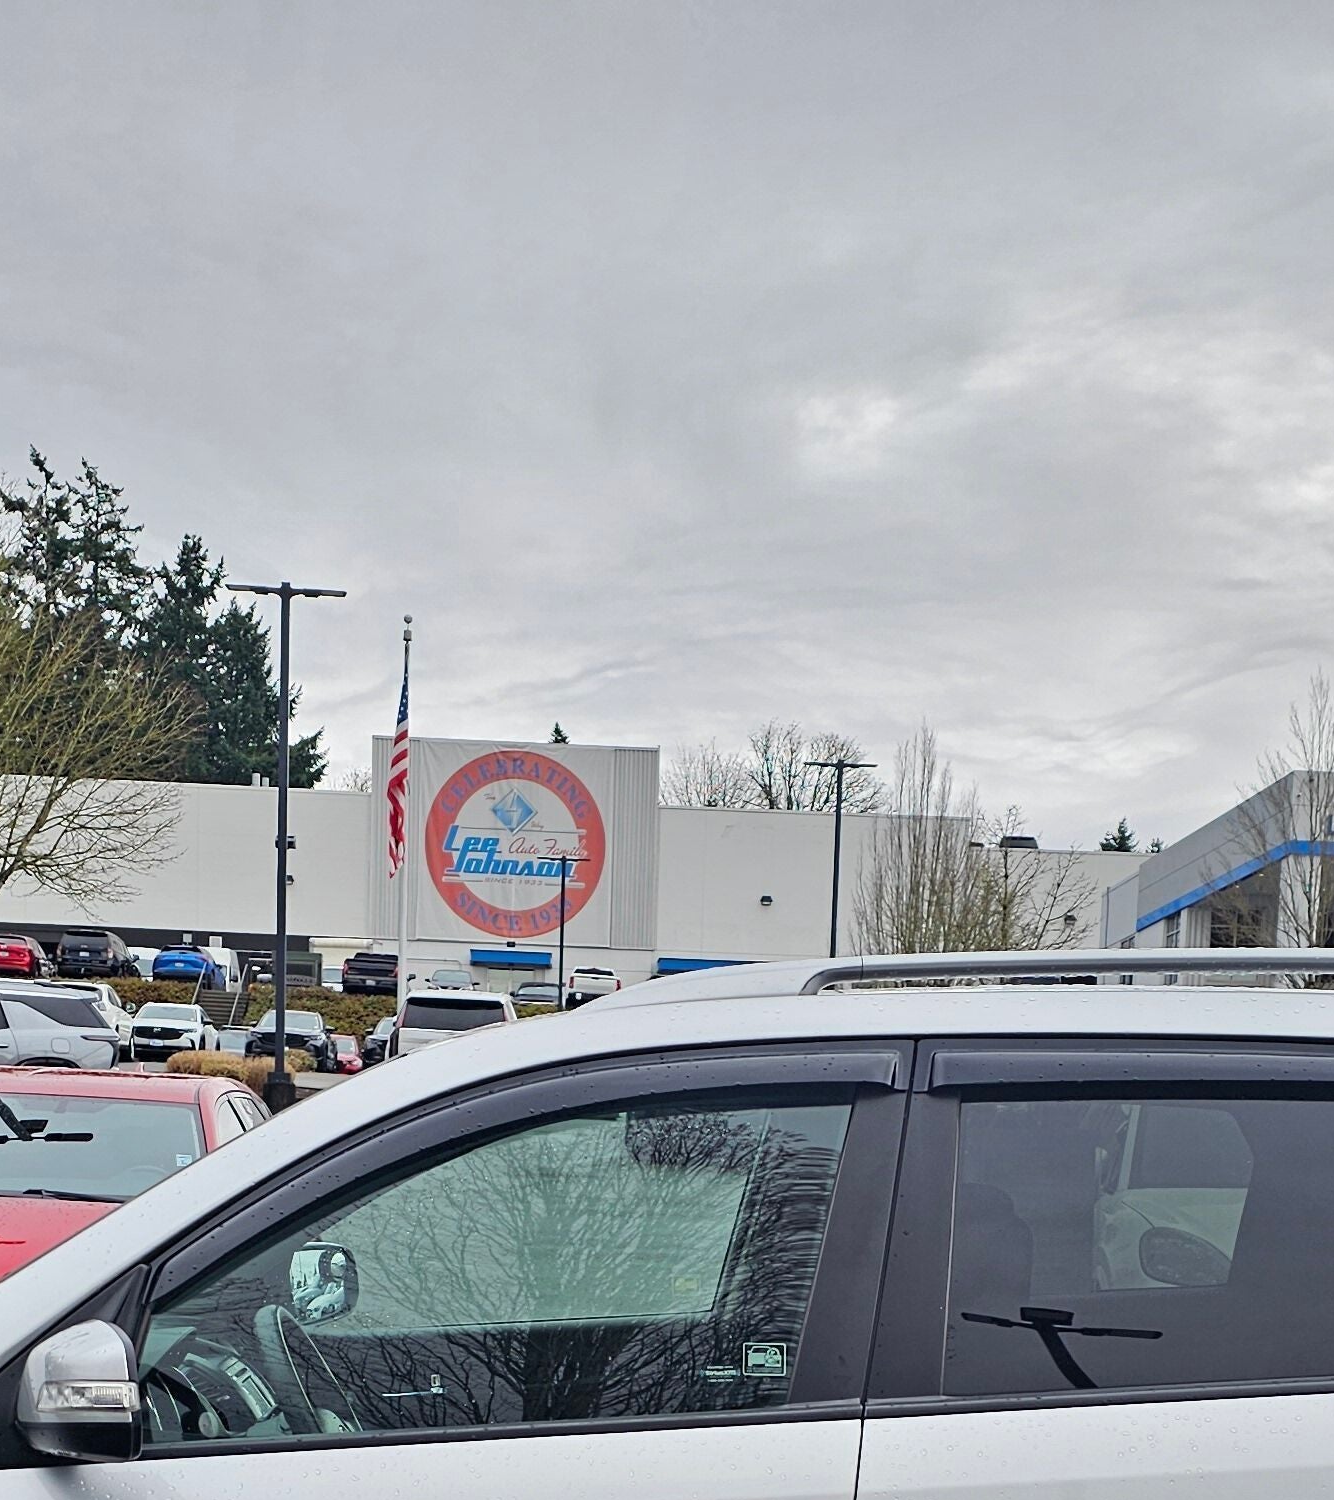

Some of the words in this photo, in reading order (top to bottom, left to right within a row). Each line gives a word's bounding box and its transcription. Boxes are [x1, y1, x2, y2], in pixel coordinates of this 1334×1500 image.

[440, 757, 590, 820] CELEBRATING
[444, 824, 501, 853] Lee
[508, 836, 540, 855] Auto
[541, 838, 588, 859] Family
[446, 847, 576, 878] Johnson
[484, 876, 514, 884] SINCE
[456, 891, 523, 931] SINCE
